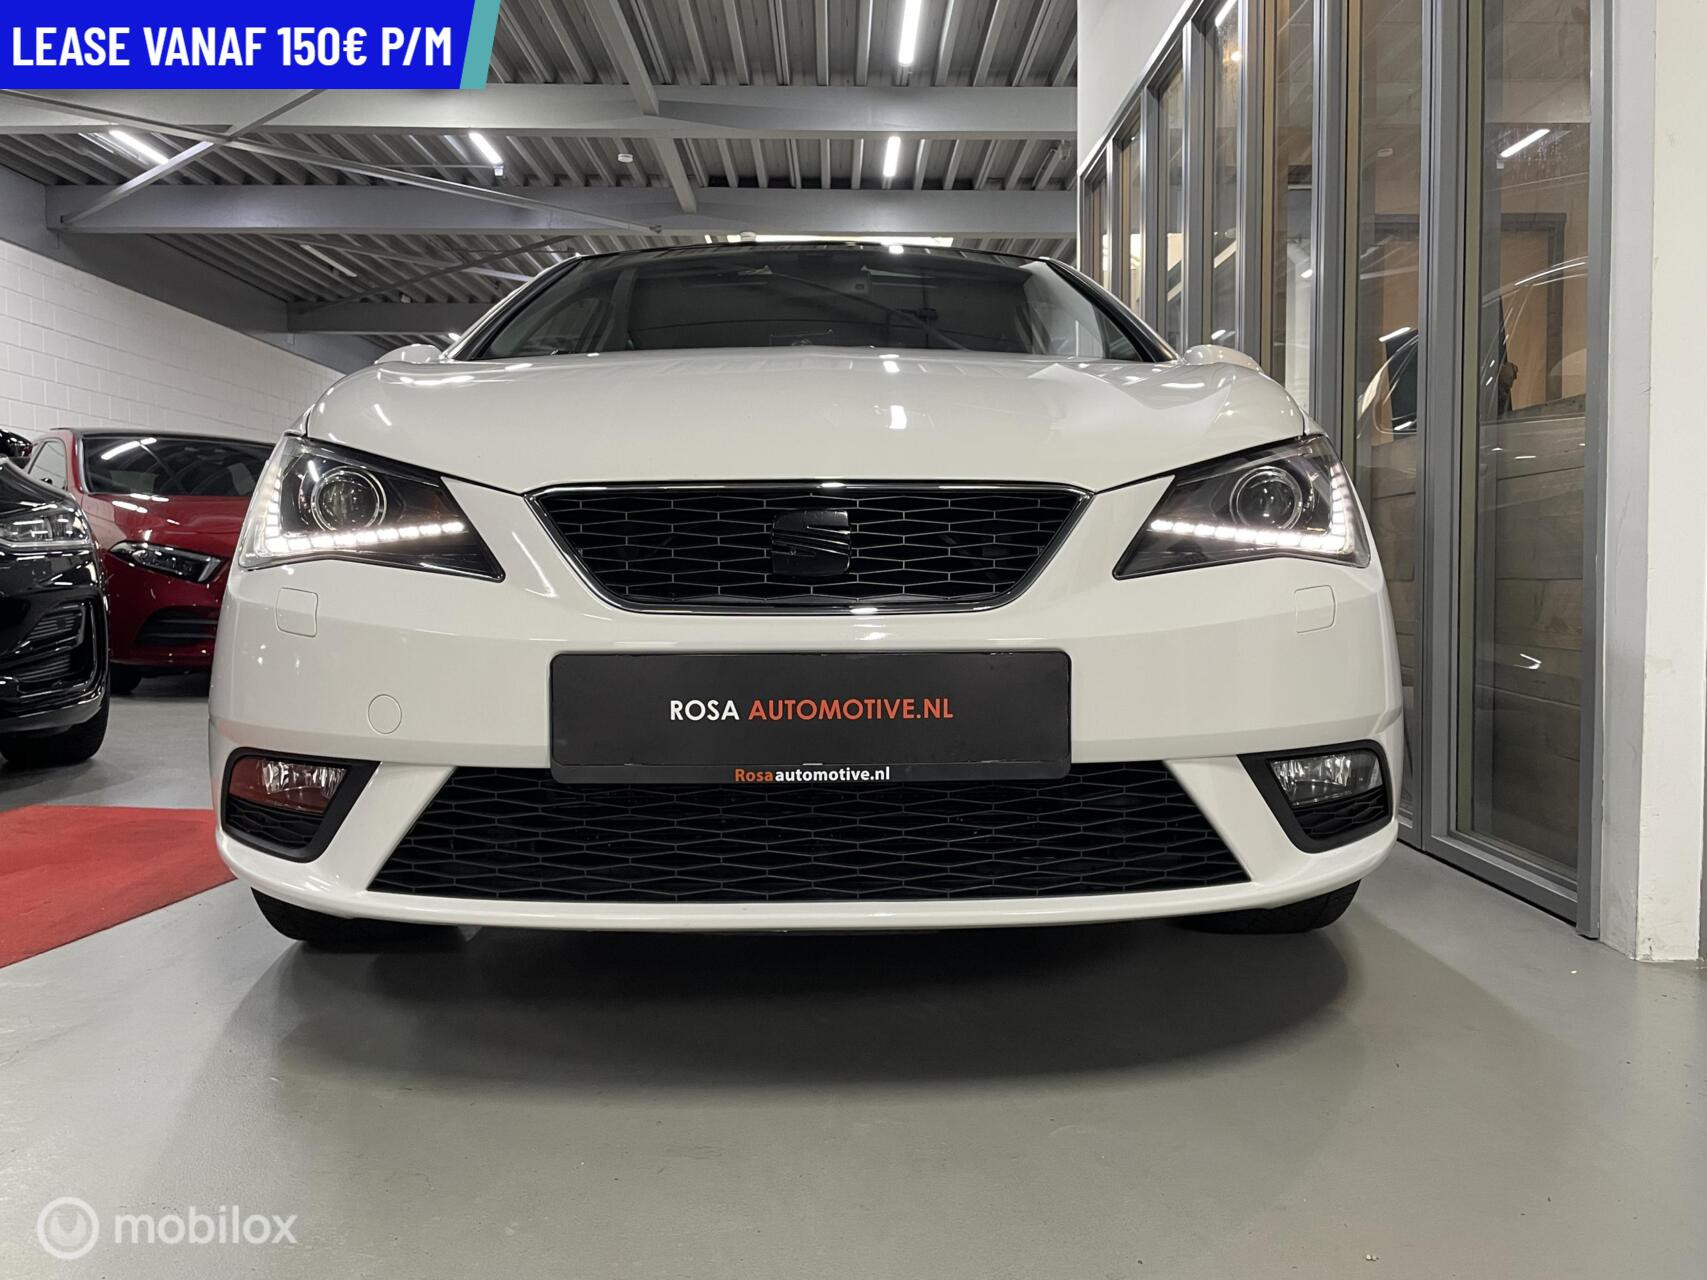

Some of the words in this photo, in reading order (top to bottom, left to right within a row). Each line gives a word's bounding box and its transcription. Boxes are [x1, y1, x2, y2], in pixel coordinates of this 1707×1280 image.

[669, 699, 740, 722] ROSA
[748, 698, 954, 721] AUTOMOTIVE.NL
[735, 766, 890, 782] Rosaautomotive.nl
